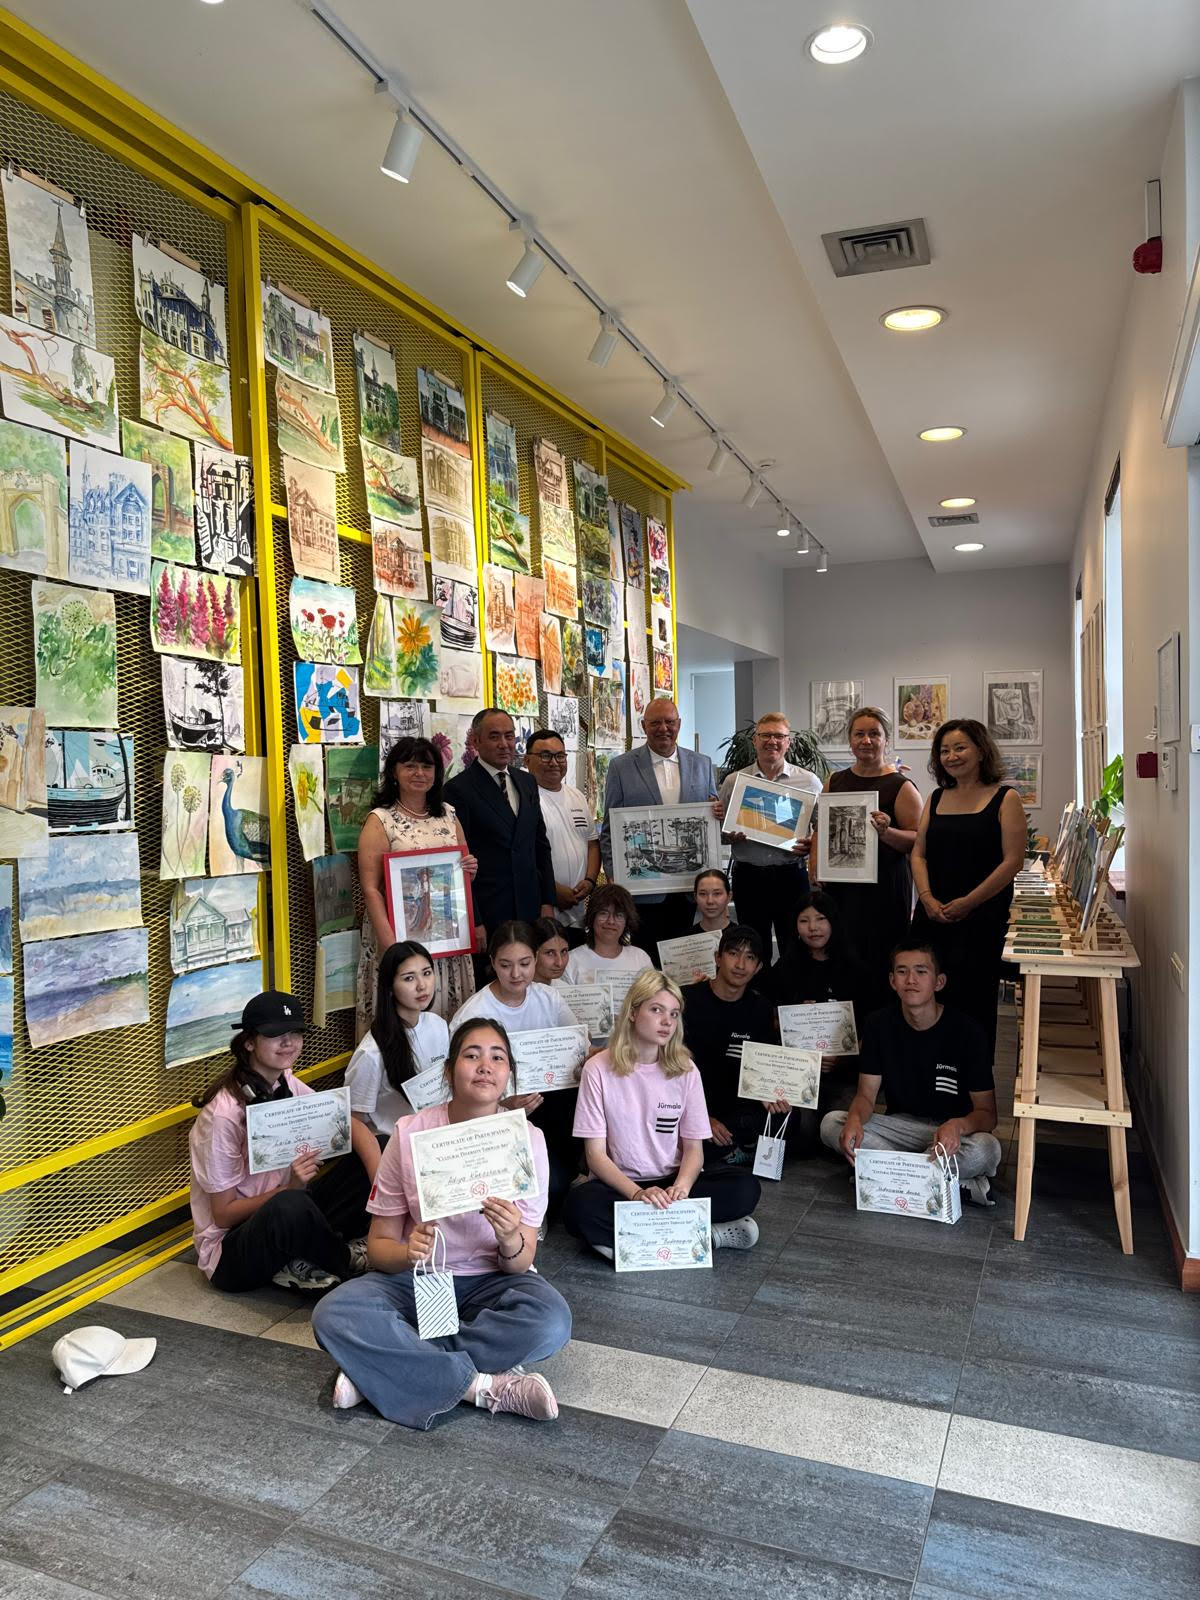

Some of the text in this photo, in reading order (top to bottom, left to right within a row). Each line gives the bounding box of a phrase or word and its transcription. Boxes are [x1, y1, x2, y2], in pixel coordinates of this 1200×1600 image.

[264, 1109, 294, 1118] CERTIFICATE
[303, 1100, 335, 1111] PARTICIPATION
[431, 1138, 465, 1150] CERTIFICATE
[474, 1128, 511, 1140] PARTICIPATION
